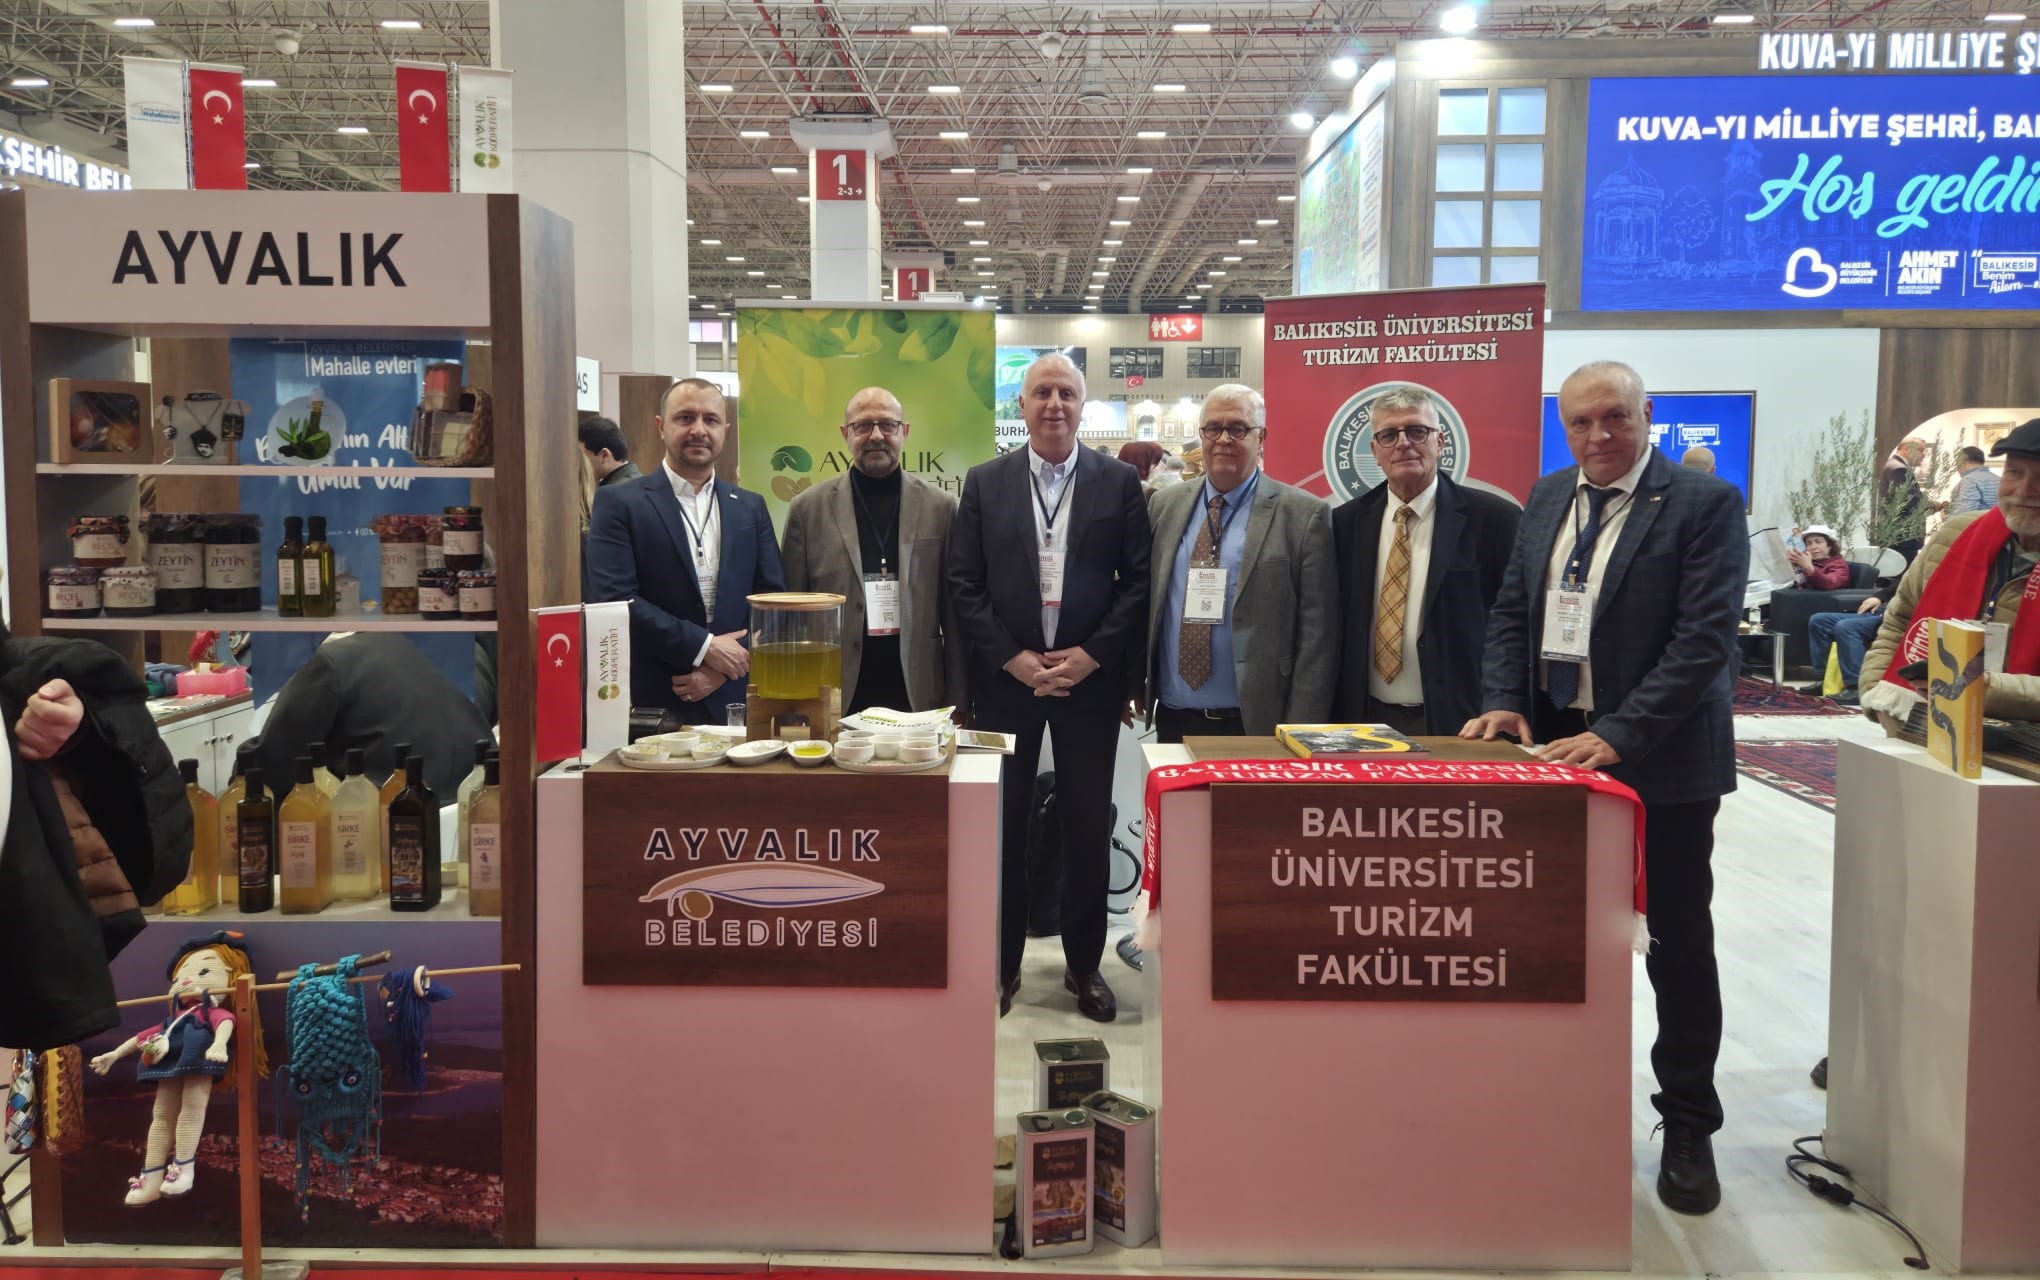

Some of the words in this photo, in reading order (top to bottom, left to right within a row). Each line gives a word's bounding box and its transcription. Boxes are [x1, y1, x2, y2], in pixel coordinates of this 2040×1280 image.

[1618, 115, 1747, 142] KUVA-YI
[1754, 107, 1880, 139] MİLLİYE
[1886, 107, 1987, 147] ŞEHRİ,
[832, 154, 847, 186] 1
[838, 187, 853, 196] 2-3
[1745, 152, 1876, 222] Hoş
[112, 230, 407, 287] AYVALIK
[1899, 251, 1959, 268] AHMET
[1982, 261, 2035, 272] BALIKESİR
[908, 271, 918, 291] 1
[1897, 267, 1942, 285] AKIN
[1982, 272, 2015, 280] Benim
[1273, 315, 1378, 342] BALIKESİR
[1383, 307, 1534, 337] ÜNİVERSİTESİ
[1303, 343, 1380, 366] TURİZM
[1384, 337, 1498, 364] FAKÜLTESİ
[311, 355, 371, 377] Mahalle
[375, 353, 417, 375] evleri
[576, 373, 588, 394] AS
[994, 425, 1031, 437] BURH
[1338, 404, 1373, 471] BALIKESİ
[819, 451, 945, 473] AYLIK
[158, 553, 193, 567] ZEYTİN
[211, 554, 246, 567] ZEYTİN
[600, 636, 609, 682] AYVALIK
[337, 823, 360, 834] SİRKE
[1302, 801, 1504, 839] BALIKESİR
[287, 833, 311, 844] SİRKE
[473, 836, 496, 847] SİRKE
[644, 828, 881, 861] AYVALIK
[1271, 849, 1534, 889] ÜNİVERSİTESİ
[1329, 899, 1473, 938] TURİZM
[645, 917, 878, 947] BELEDİYESİ
[1297, 948, 1507, 988] FAKÜLTESİ
